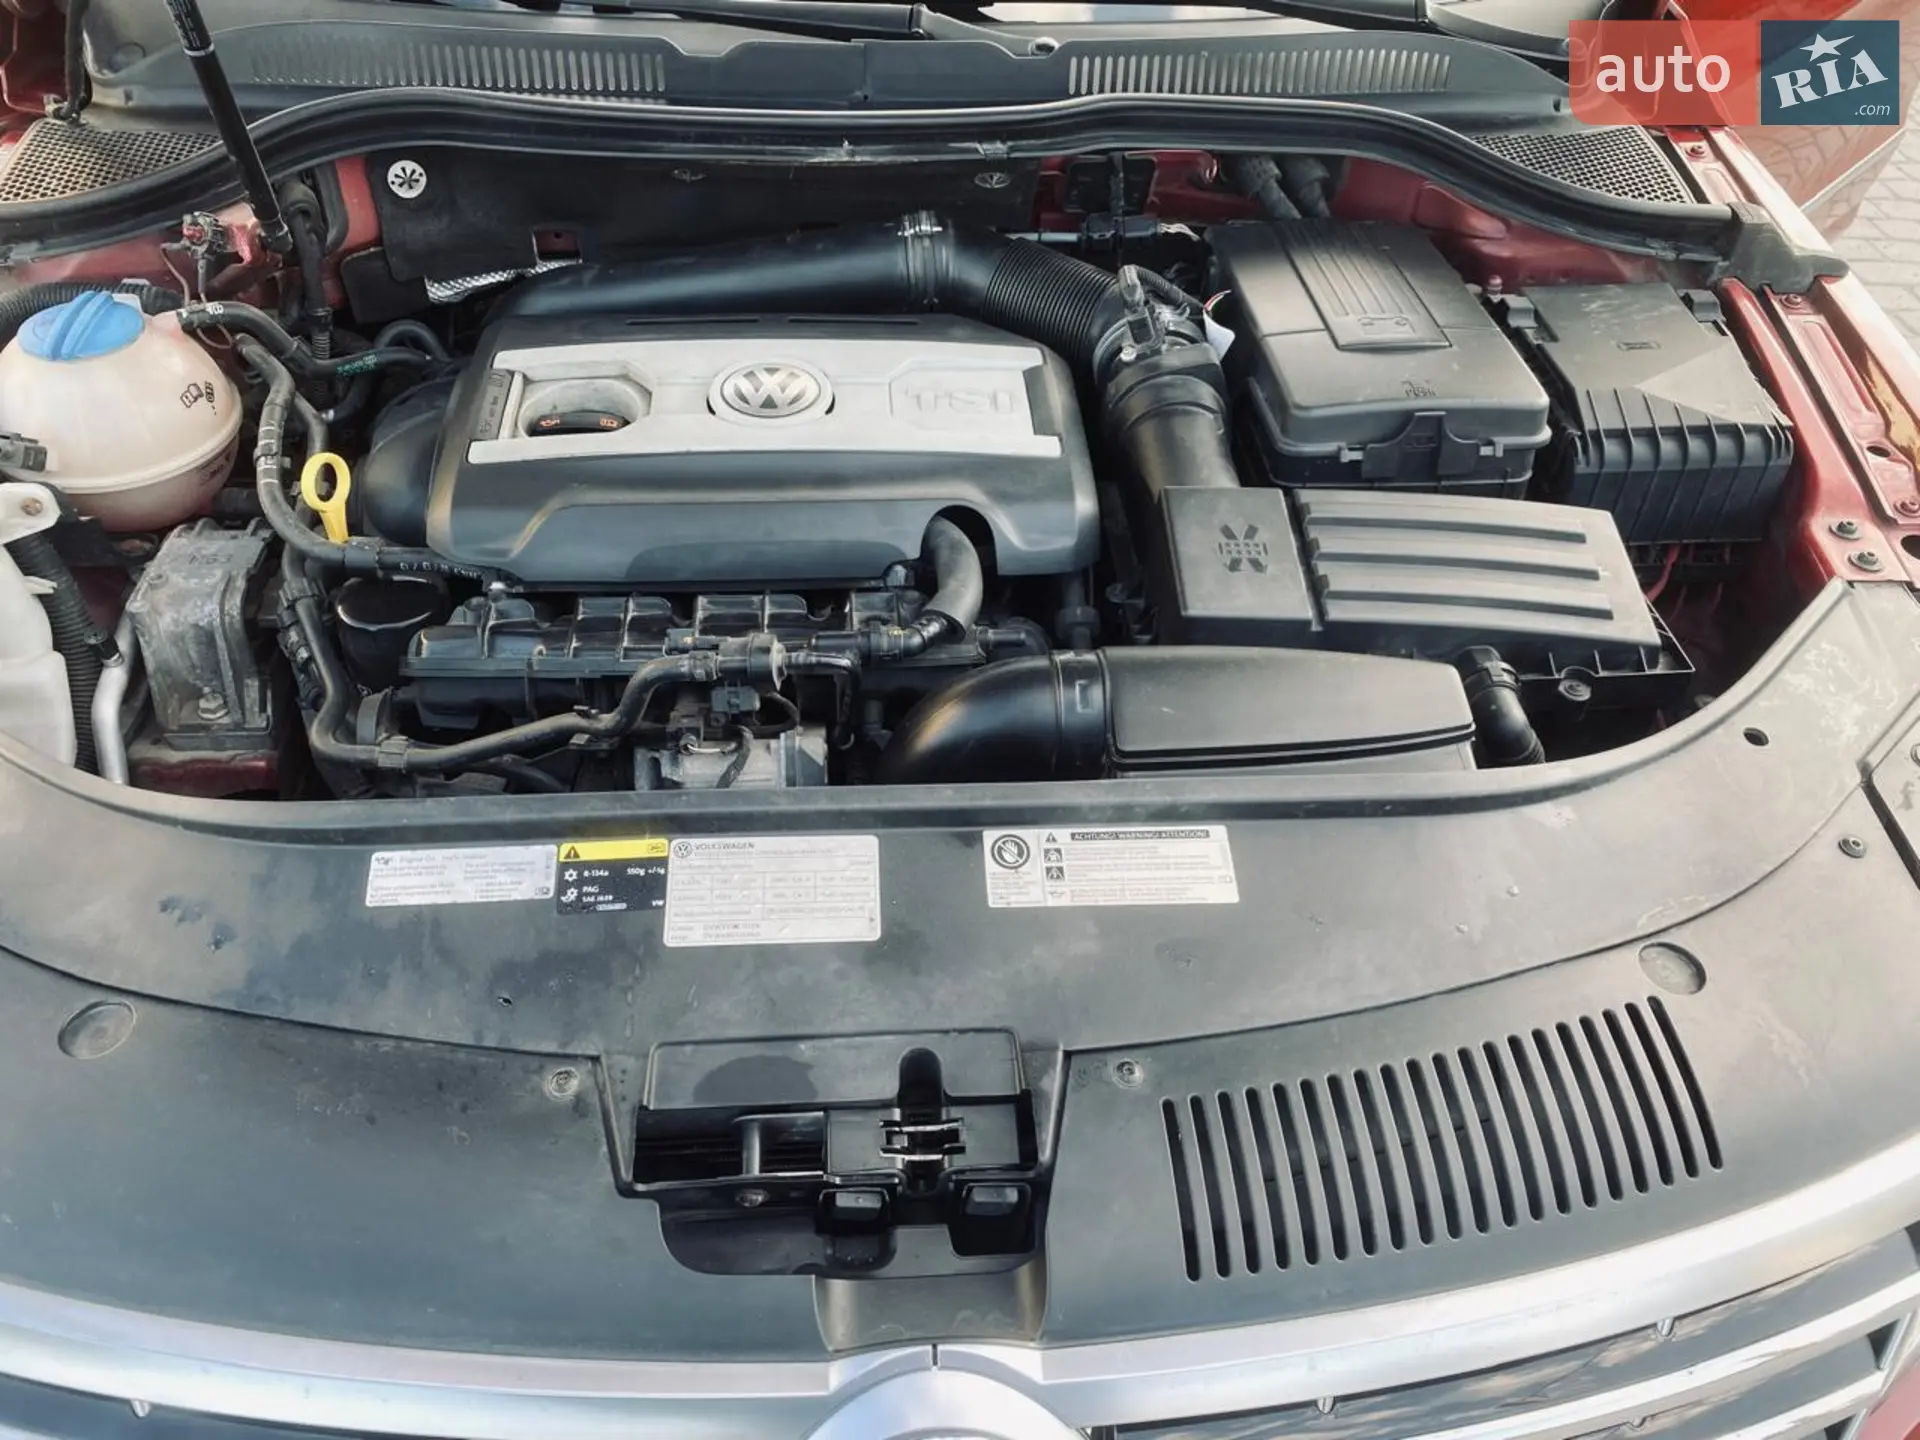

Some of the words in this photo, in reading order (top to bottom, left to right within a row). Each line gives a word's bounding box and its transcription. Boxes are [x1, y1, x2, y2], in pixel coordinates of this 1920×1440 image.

[906, 387, 1015, 416] TSI
[694, 841, 756, 851] VOLKSWAGEN
[582, 885, 599, 893] PAG
